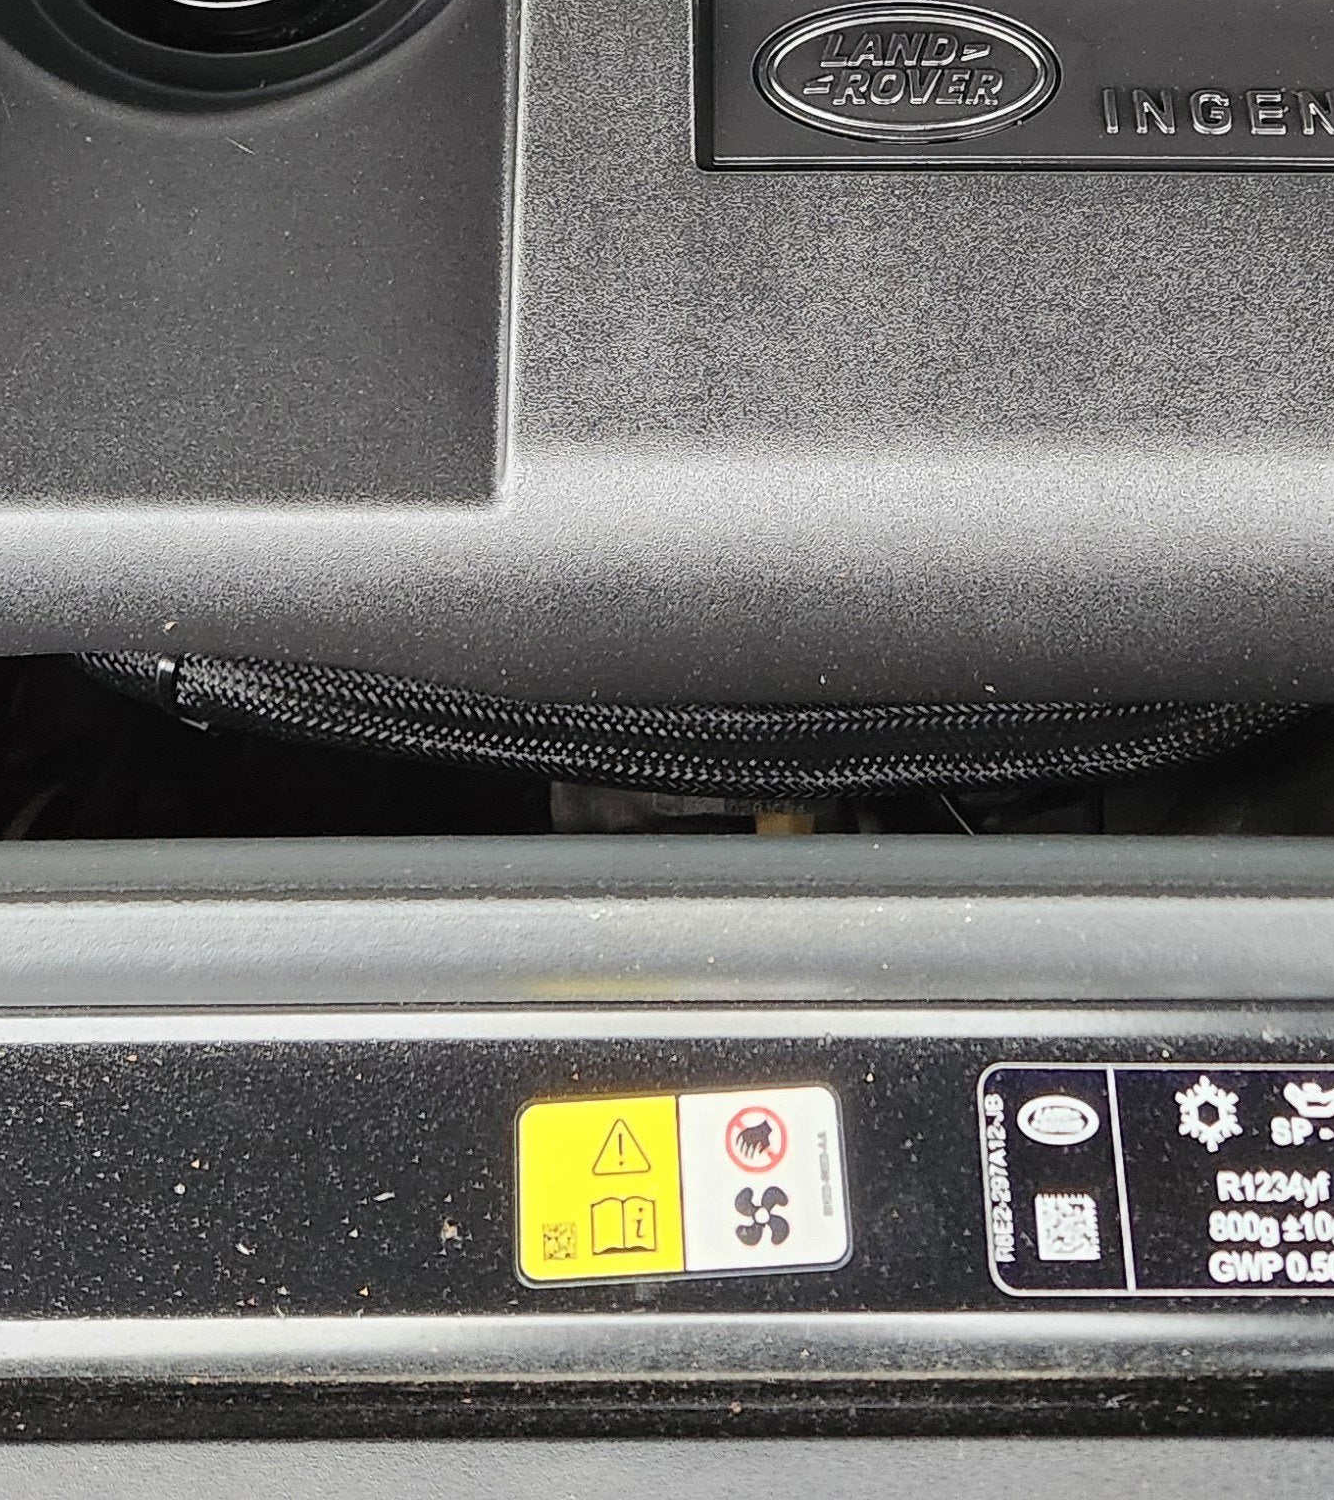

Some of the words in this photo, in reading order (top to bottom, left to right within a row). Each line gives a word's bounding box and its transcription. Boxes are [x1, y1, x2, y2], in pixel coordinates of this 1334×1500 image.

[819, 32, 959, 68] LAND
[831, 68, 1005, 106] ROVER
[1270, 1116, 1314, 1146] SP
[1216, 1170, 1331, 1208] R1234yf
[1208, 1210, 1281, 1248] 800g
[1208, 1250, 1284, 1283] GWP
